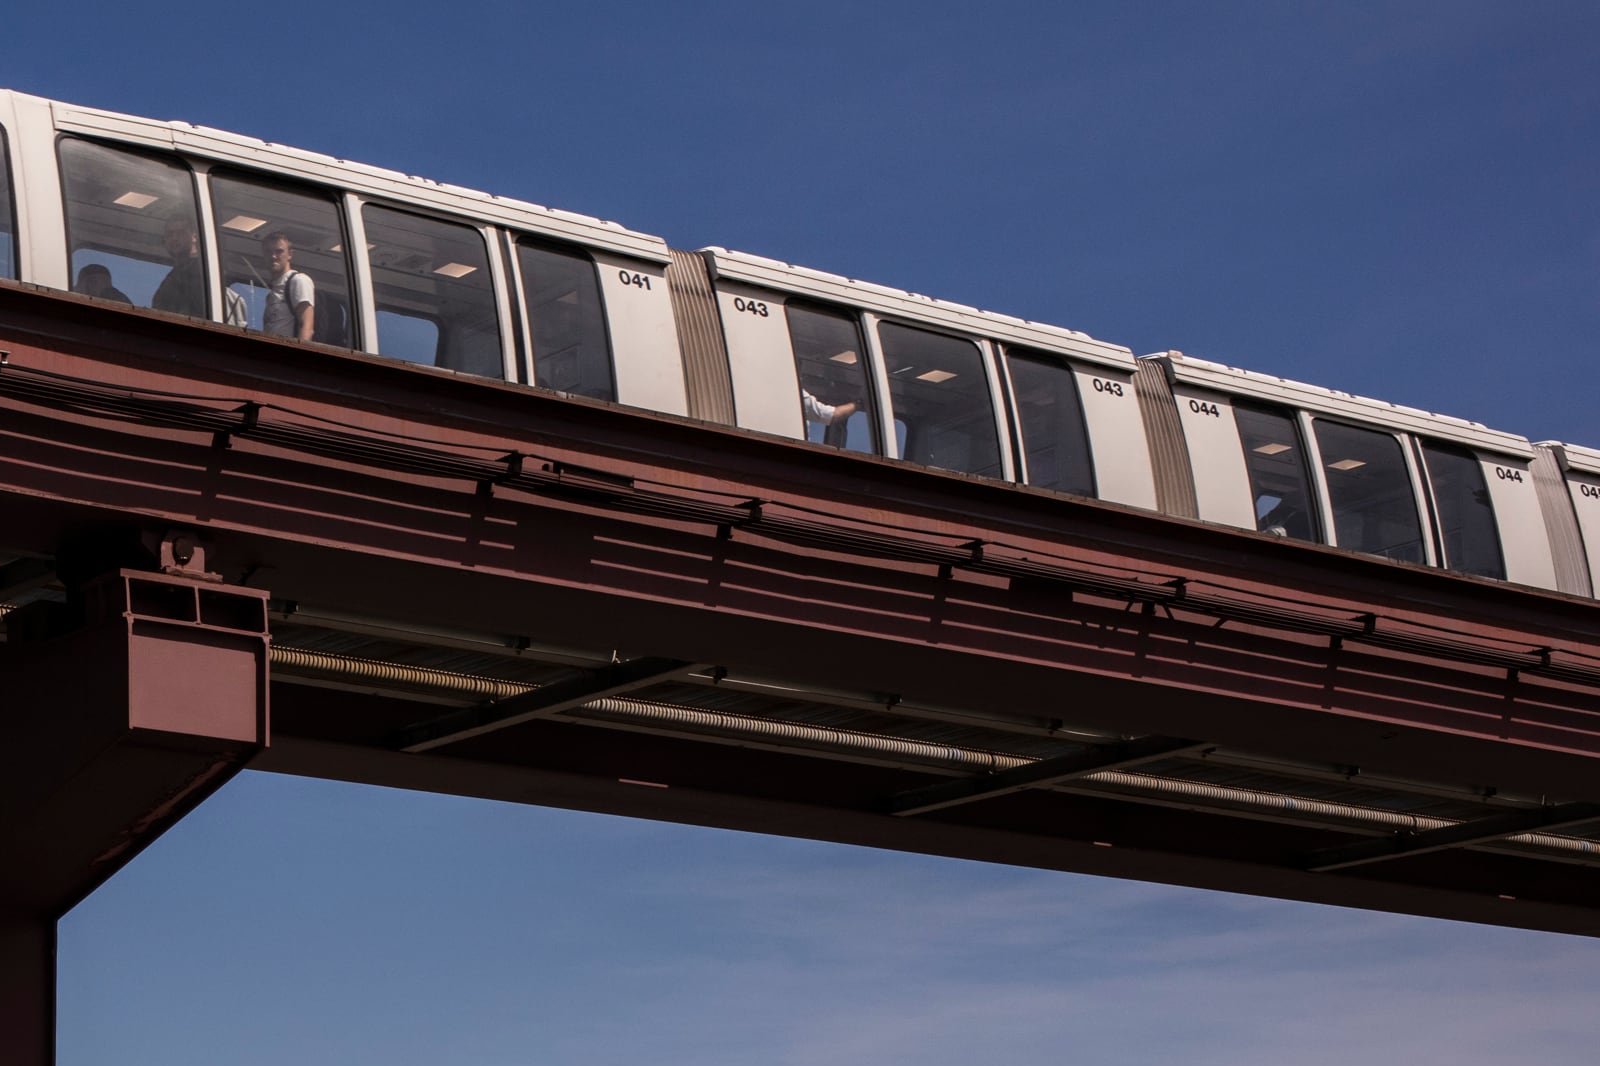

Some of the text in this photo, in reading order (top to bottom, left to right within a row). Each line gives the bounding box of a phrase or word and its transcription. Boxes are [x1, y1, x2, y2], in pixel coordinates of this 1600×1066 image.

[618, 270, 652, 291] 041
[734, 297, 769, 318] 043
[1092, 378, 1124, 397] 043
[1189, 399, 1220, 418] 044
[1495, 466, 1523, 483] 044
[1580, 483, 1600, 499] 04
